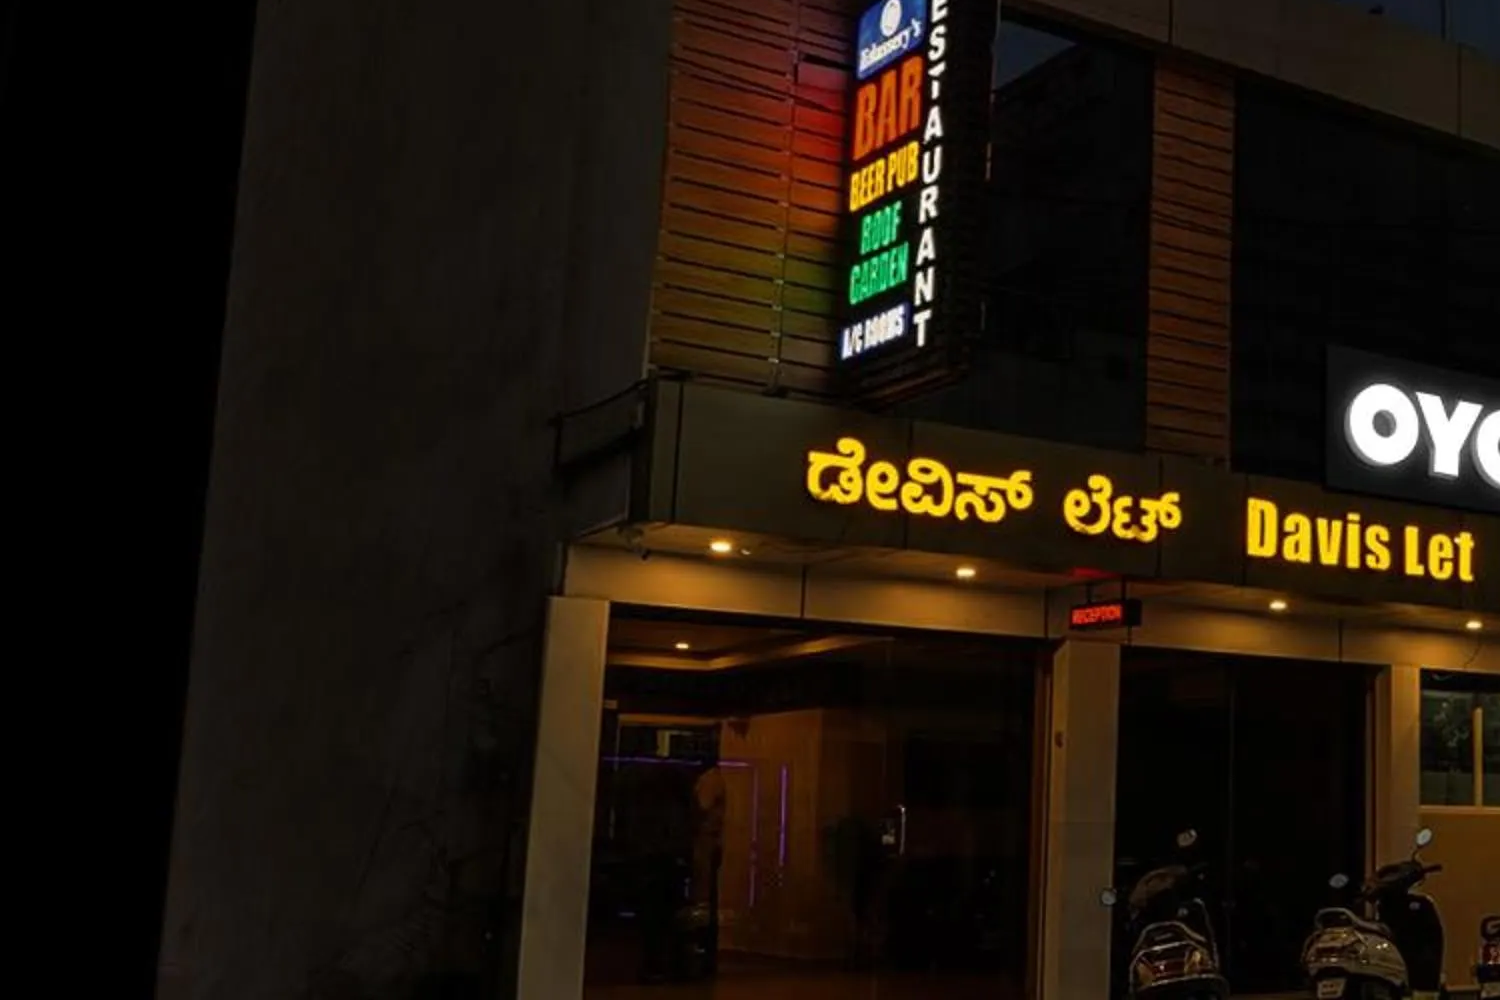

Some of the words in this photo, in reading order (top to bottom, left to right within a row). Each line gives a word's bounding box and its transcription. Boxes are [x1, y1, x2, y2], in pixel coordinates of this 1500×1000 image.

[852, 55, 924, 161] BAR
[849, 156, 886, 212] BEER
[887, 140, 919, 192] PUB
[860, 201, 903, 255] ROOF
[849, 241, 909, 305] GARDEN
[806, 437, 1034, 523] ಡೇವಿಸ್
[1063, 474, 1183, 543] ಲೆಟ್
[1246, 497, 1392, 570] Davis
[1404, 525, 1475, 583] Let
